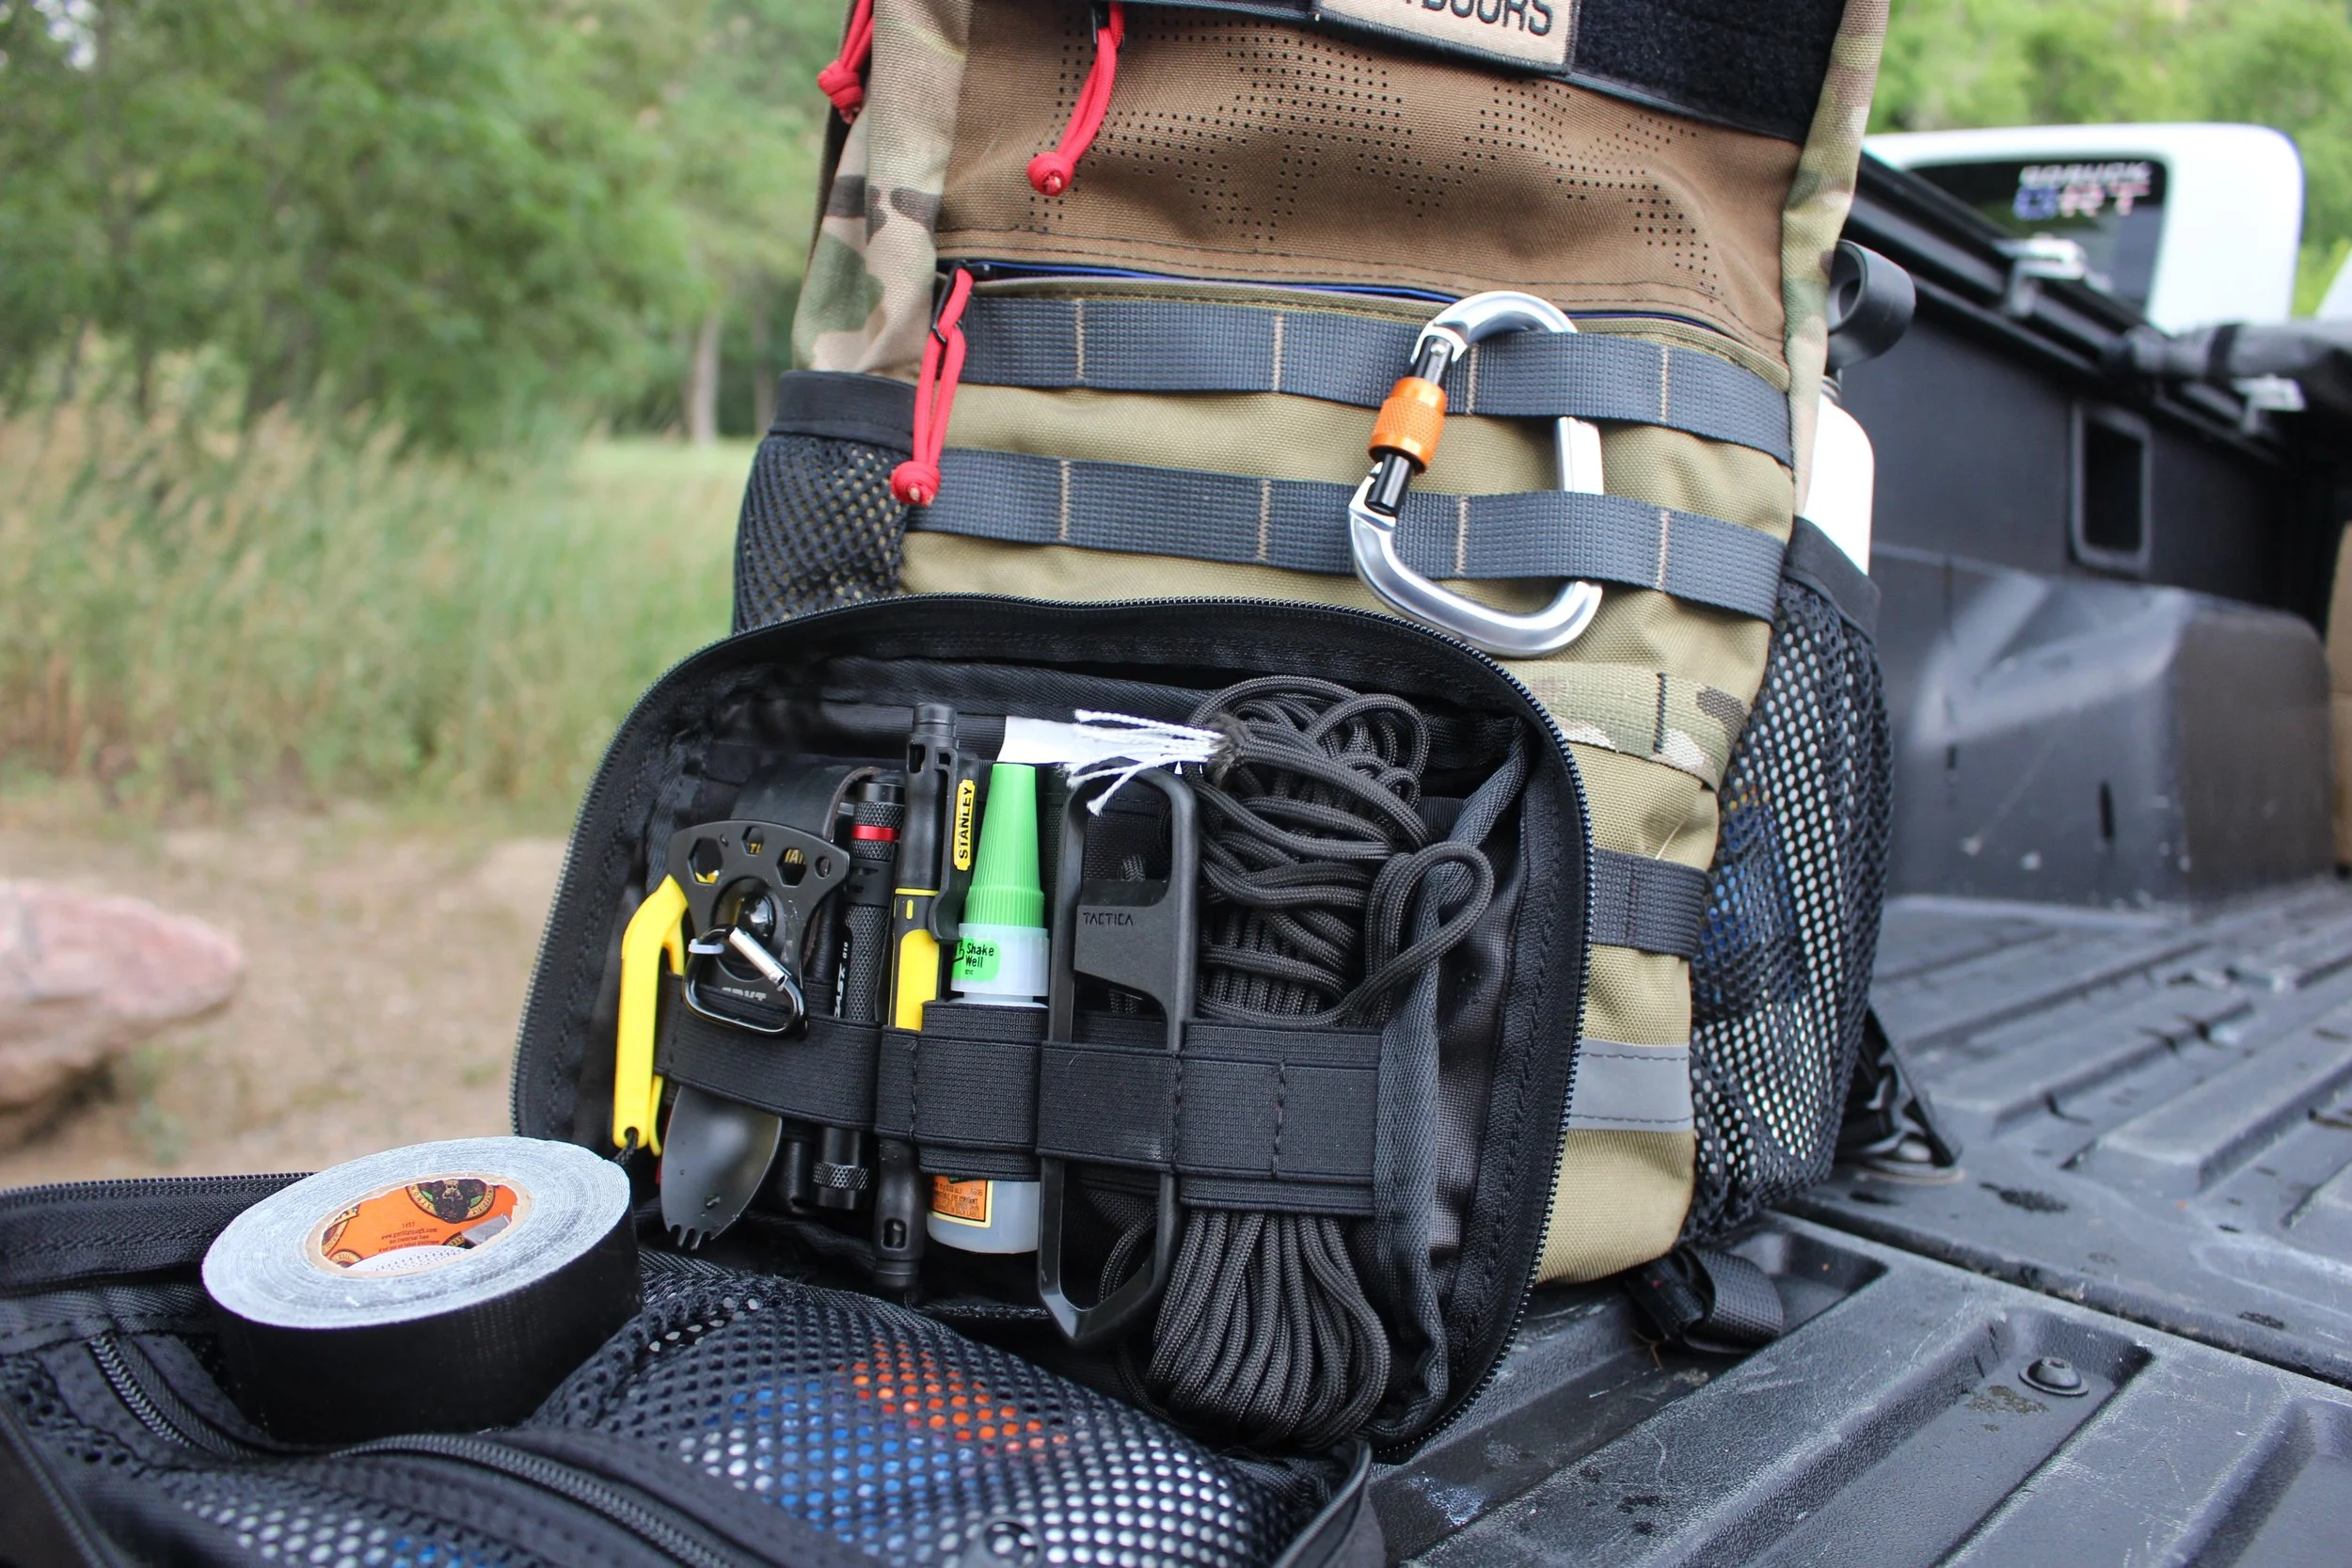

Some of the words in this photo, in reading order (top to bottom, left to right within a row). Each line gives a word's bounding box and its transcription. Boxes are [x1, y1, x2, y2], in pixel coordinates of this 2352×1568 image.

[960, 787, 972, 859] STANLEY
[1083, 912, 1134, 927] TACTICA
[966, 942, 994, 957] Shake
[965, 955, 984, 968] Well
